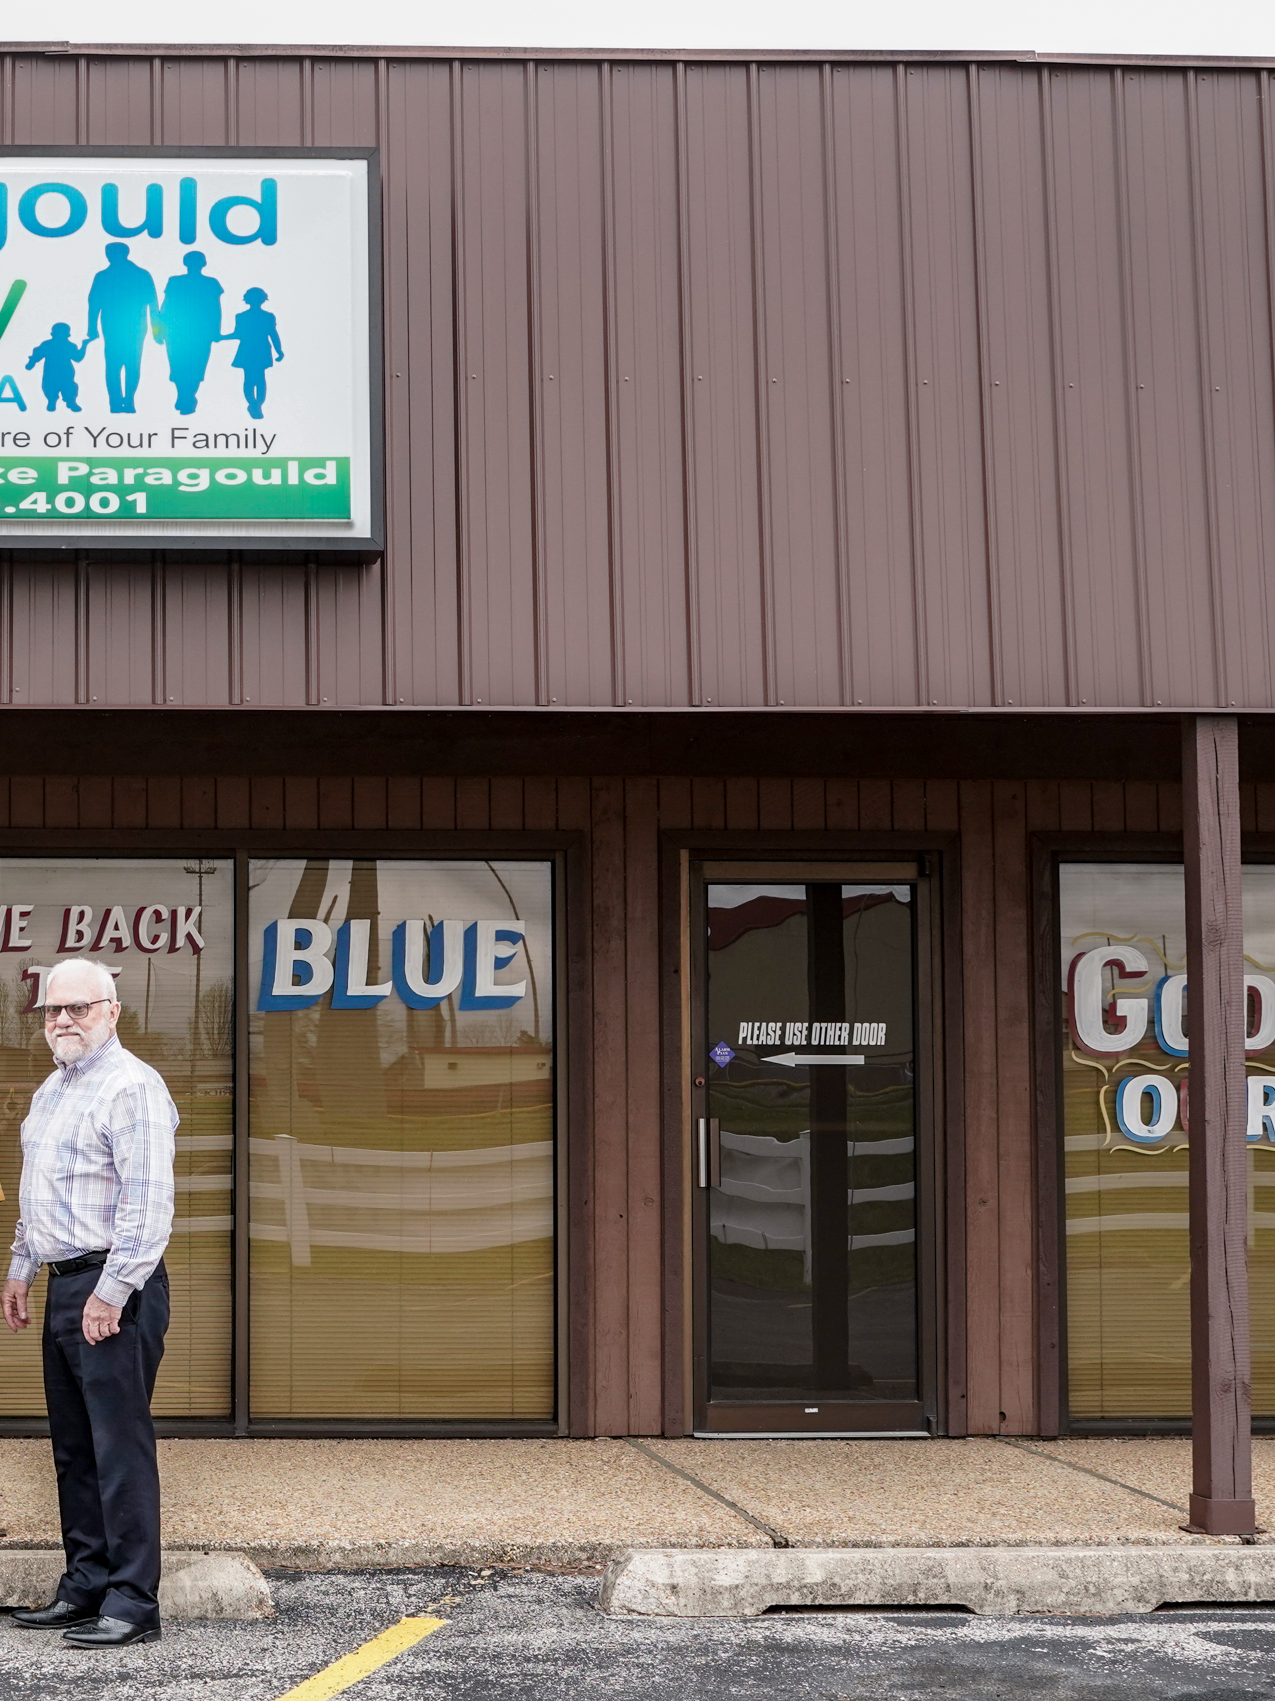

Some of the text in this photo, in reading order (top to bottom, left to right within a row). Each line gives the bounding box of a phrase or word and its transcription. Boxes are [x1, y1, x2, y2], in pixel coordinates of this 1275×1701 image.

[43, 427, 75, 448] of
[84, 427, 158, 449] Your
[170, 428, 277, 455] Family
[57, 460, 337, 492] Paragould
[56, 904, 205, 955] BACK
[257, 919, 526, 1011] BLUE
[738, 1022, 887, 1046] PLEASE USE OTHER DOOR
